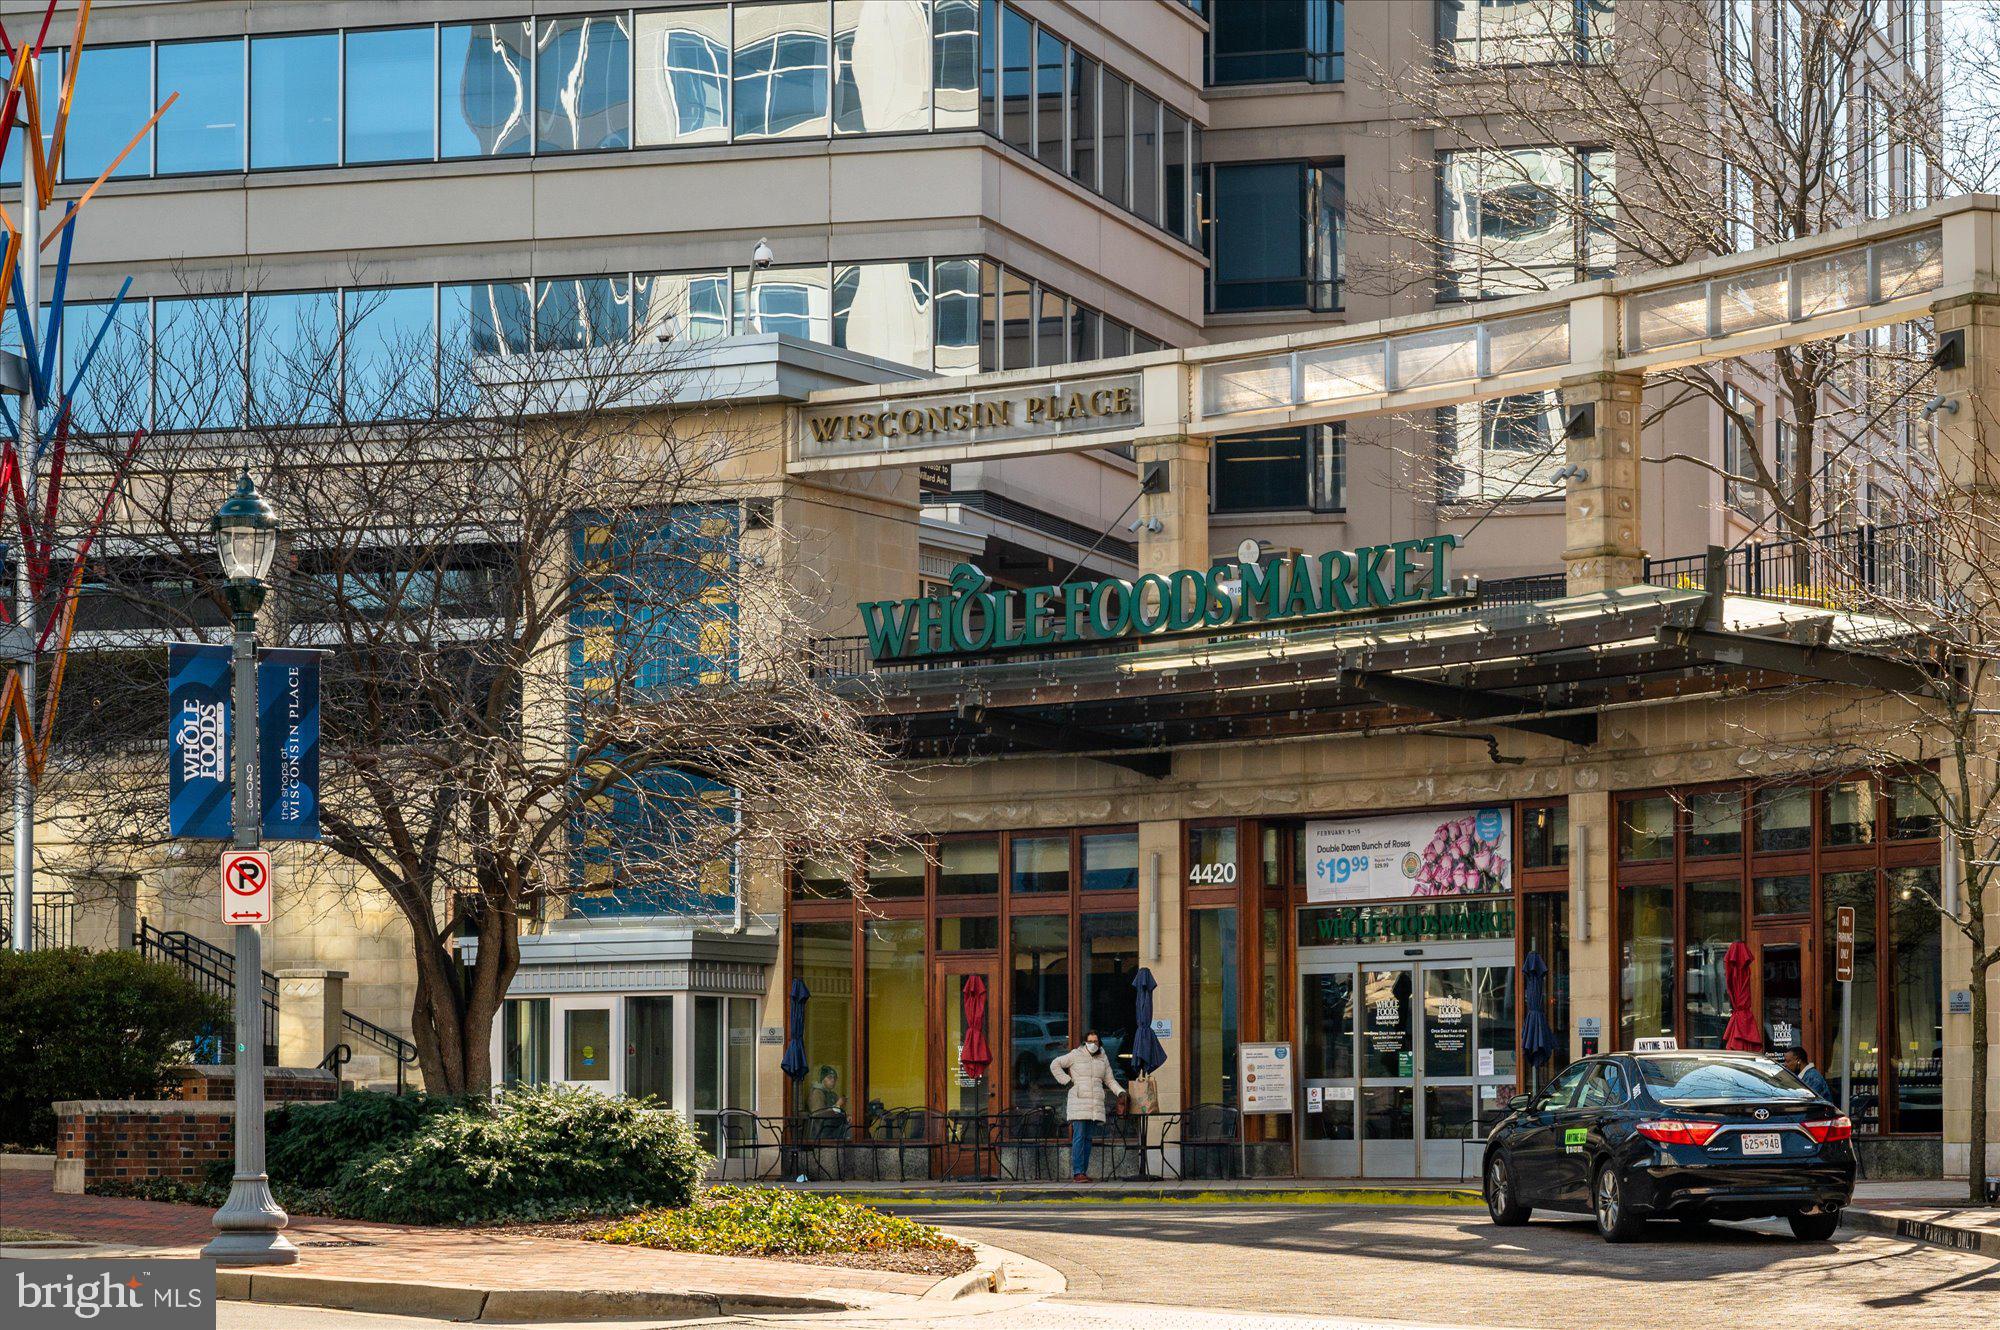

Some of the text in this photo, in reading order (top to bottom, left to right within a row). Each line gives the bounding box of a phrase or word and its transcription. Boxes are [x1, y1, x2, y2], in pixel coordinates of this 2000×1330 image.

[806, 386, 1134, 443] WISCONSIN PLACE
[858, 534, 1458, 661] WHOLE FOODS MARKET
[176, 699, 200, 782] WHOLE
[200, 704, 217, 780] FOODS
[289, 667, 300, 821] WISCONSIN PLACE
[281, 747, 288, 760] at
[281, 762, 289, 797] shops
[1316, 840, 1411, 854] Double Dozen Bunch of Roses
[1189, 862, 1236, 884] 4420
[1375, 999, 1400, 1008] WHOLE
[1376, 1008, 1399, 1016] FOODS
[1438, 1006, 1462, 1014] FOODS
[1773, 1021, 1792, 1031] WHOLE
[1773, 1031, 1792, 1039] FOODS
[1639, 1040, 1675, 1050] ANYTIME TAXI
[1905, 1220, 1975, 1250] TAXI PARKING ONLY
